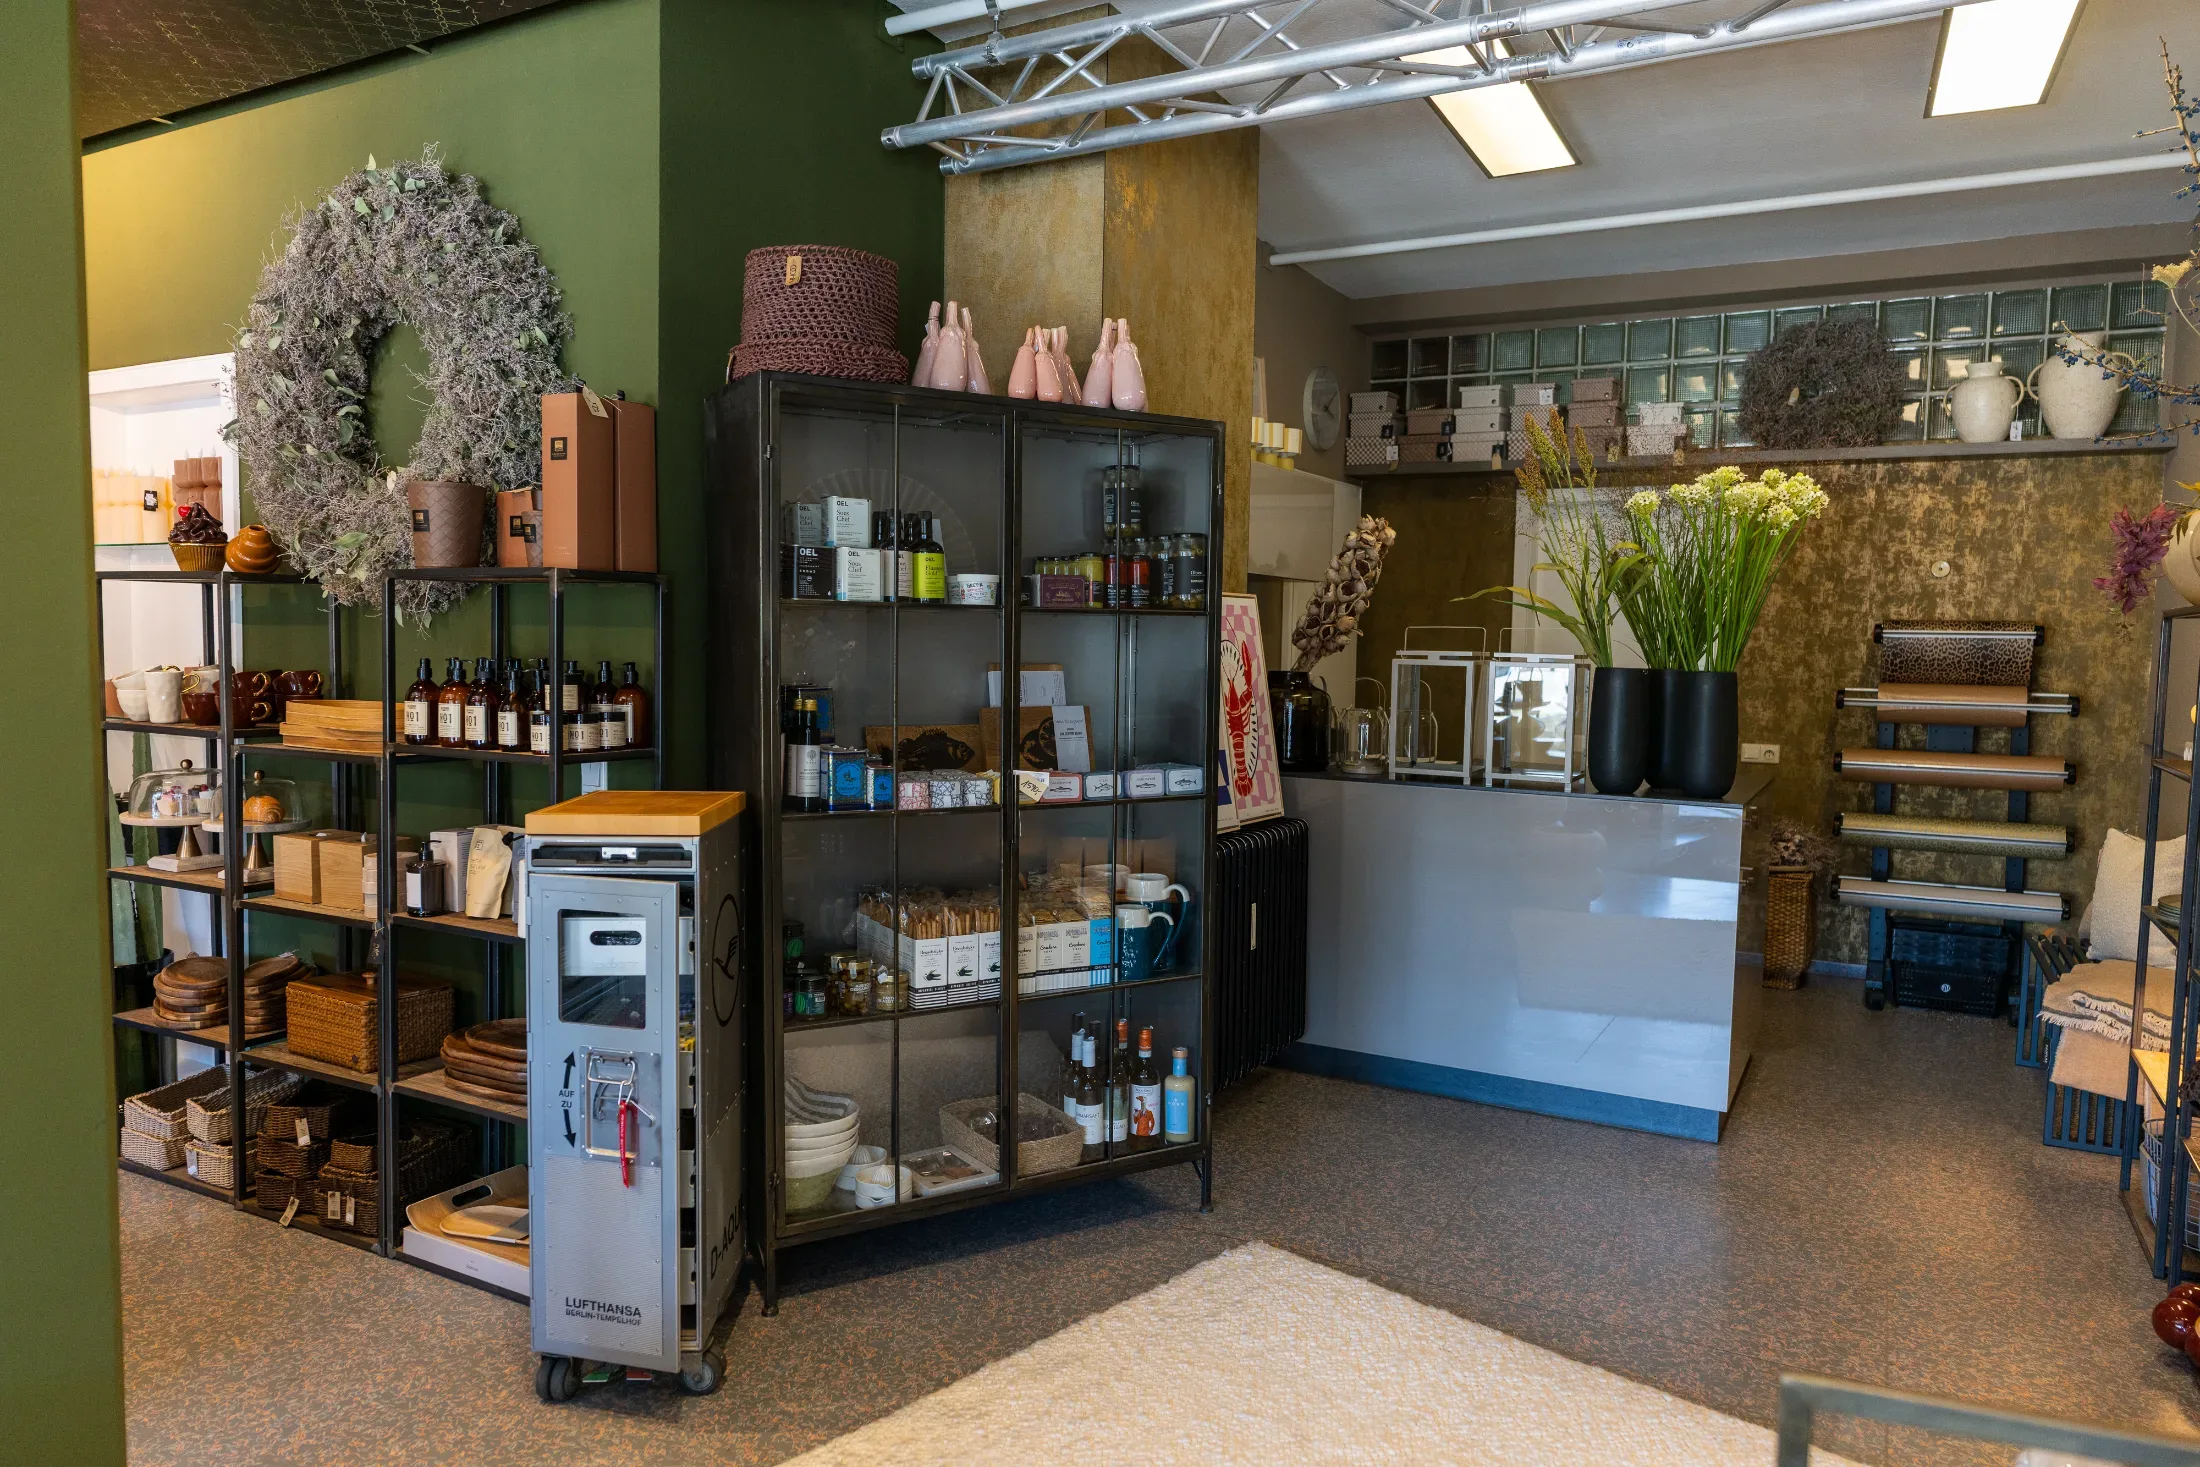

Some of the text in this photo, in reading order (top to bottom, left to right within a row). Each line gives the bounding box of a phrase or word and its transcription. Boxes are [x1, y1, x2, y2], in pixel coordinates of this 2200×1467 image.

[799, 548, 818, 557] OEL
[558, 1089, 575, 1098] AUF
[560, 1100, 573, 1108] ZU
[565, 1296, 642, 1318] LUFTHANSA
[565, 1308, 642, 1326] BERLIN-TEMPELHOF
